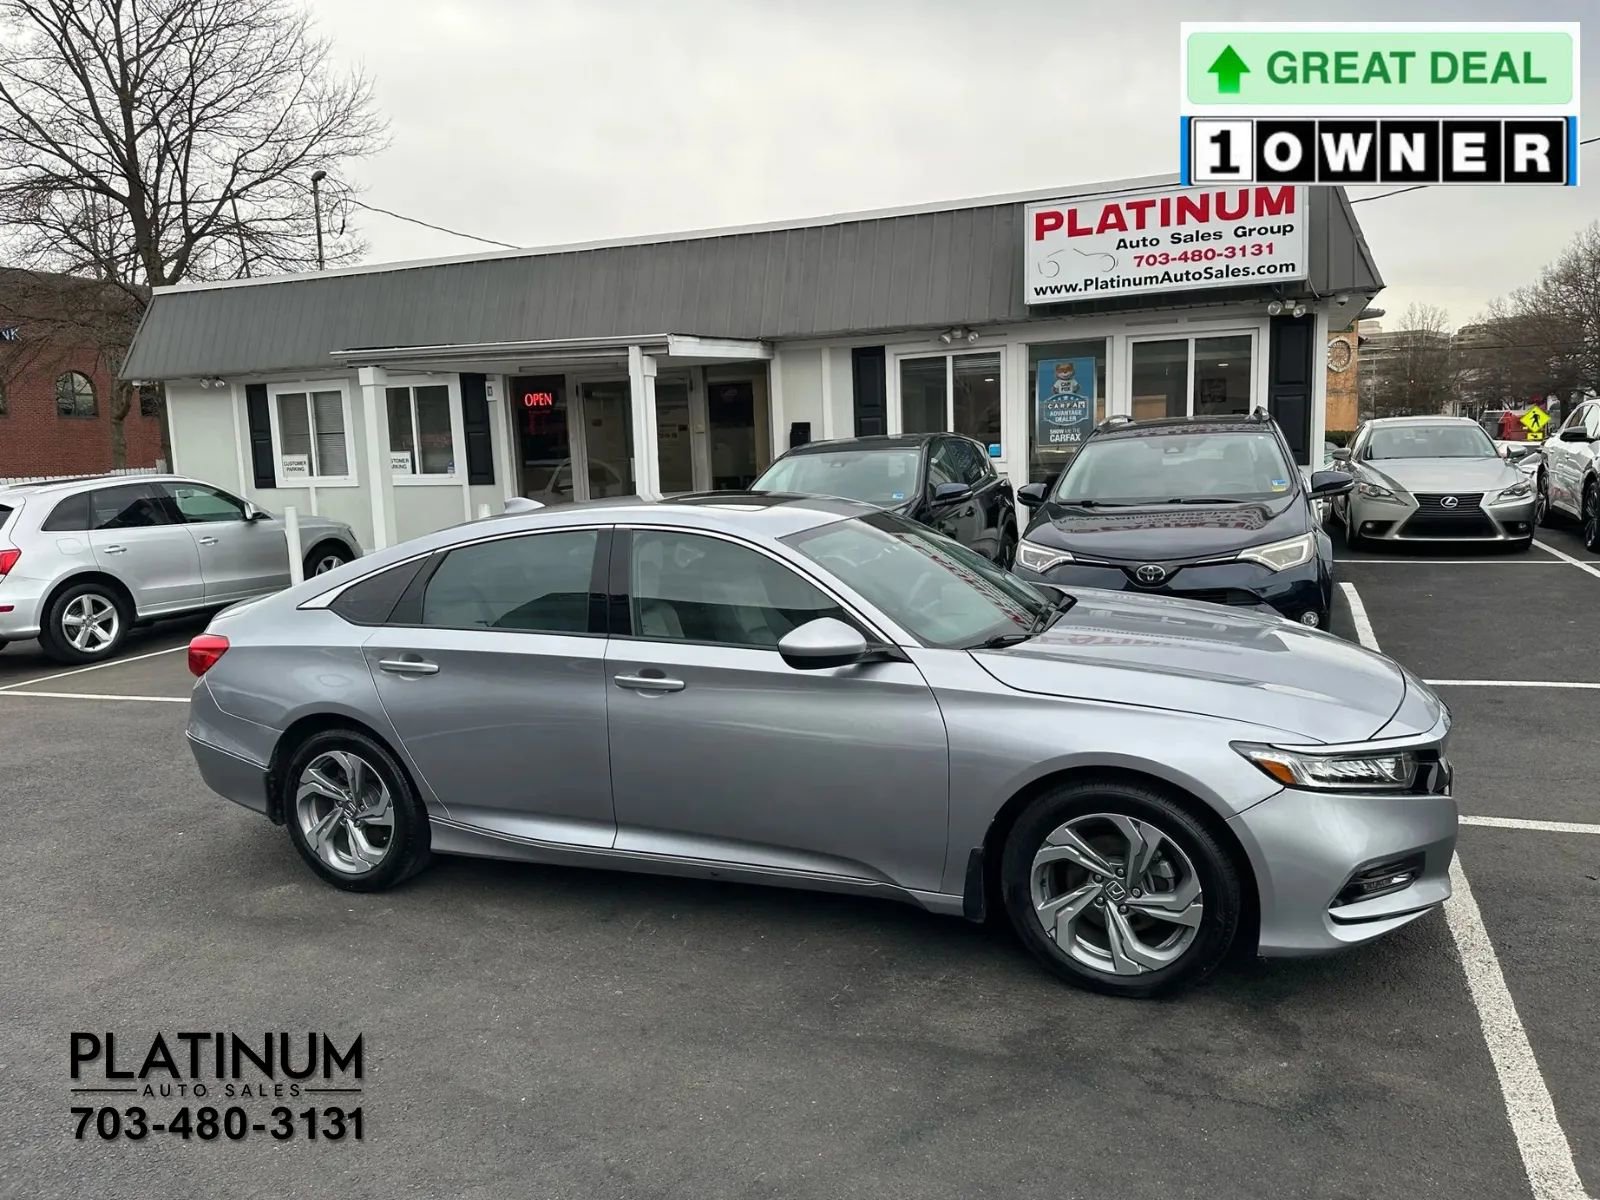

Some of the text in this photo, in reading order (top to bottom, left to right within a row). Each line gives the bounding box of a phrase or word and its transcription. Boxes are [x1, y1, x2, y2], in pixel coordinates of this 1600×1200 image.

[1034, 185, 1296, 241] PLATINUM
[1115, 222, 1295, 251] Auto Sales Group
[1133, 242, 1275, 268] 703-480-3131
[1033, 261, 1296, 296] www.PlatinumAutoSales.com
[524, 392, 552, 407] OPEN
[1049, 434, 1081, 442] CARFAX
